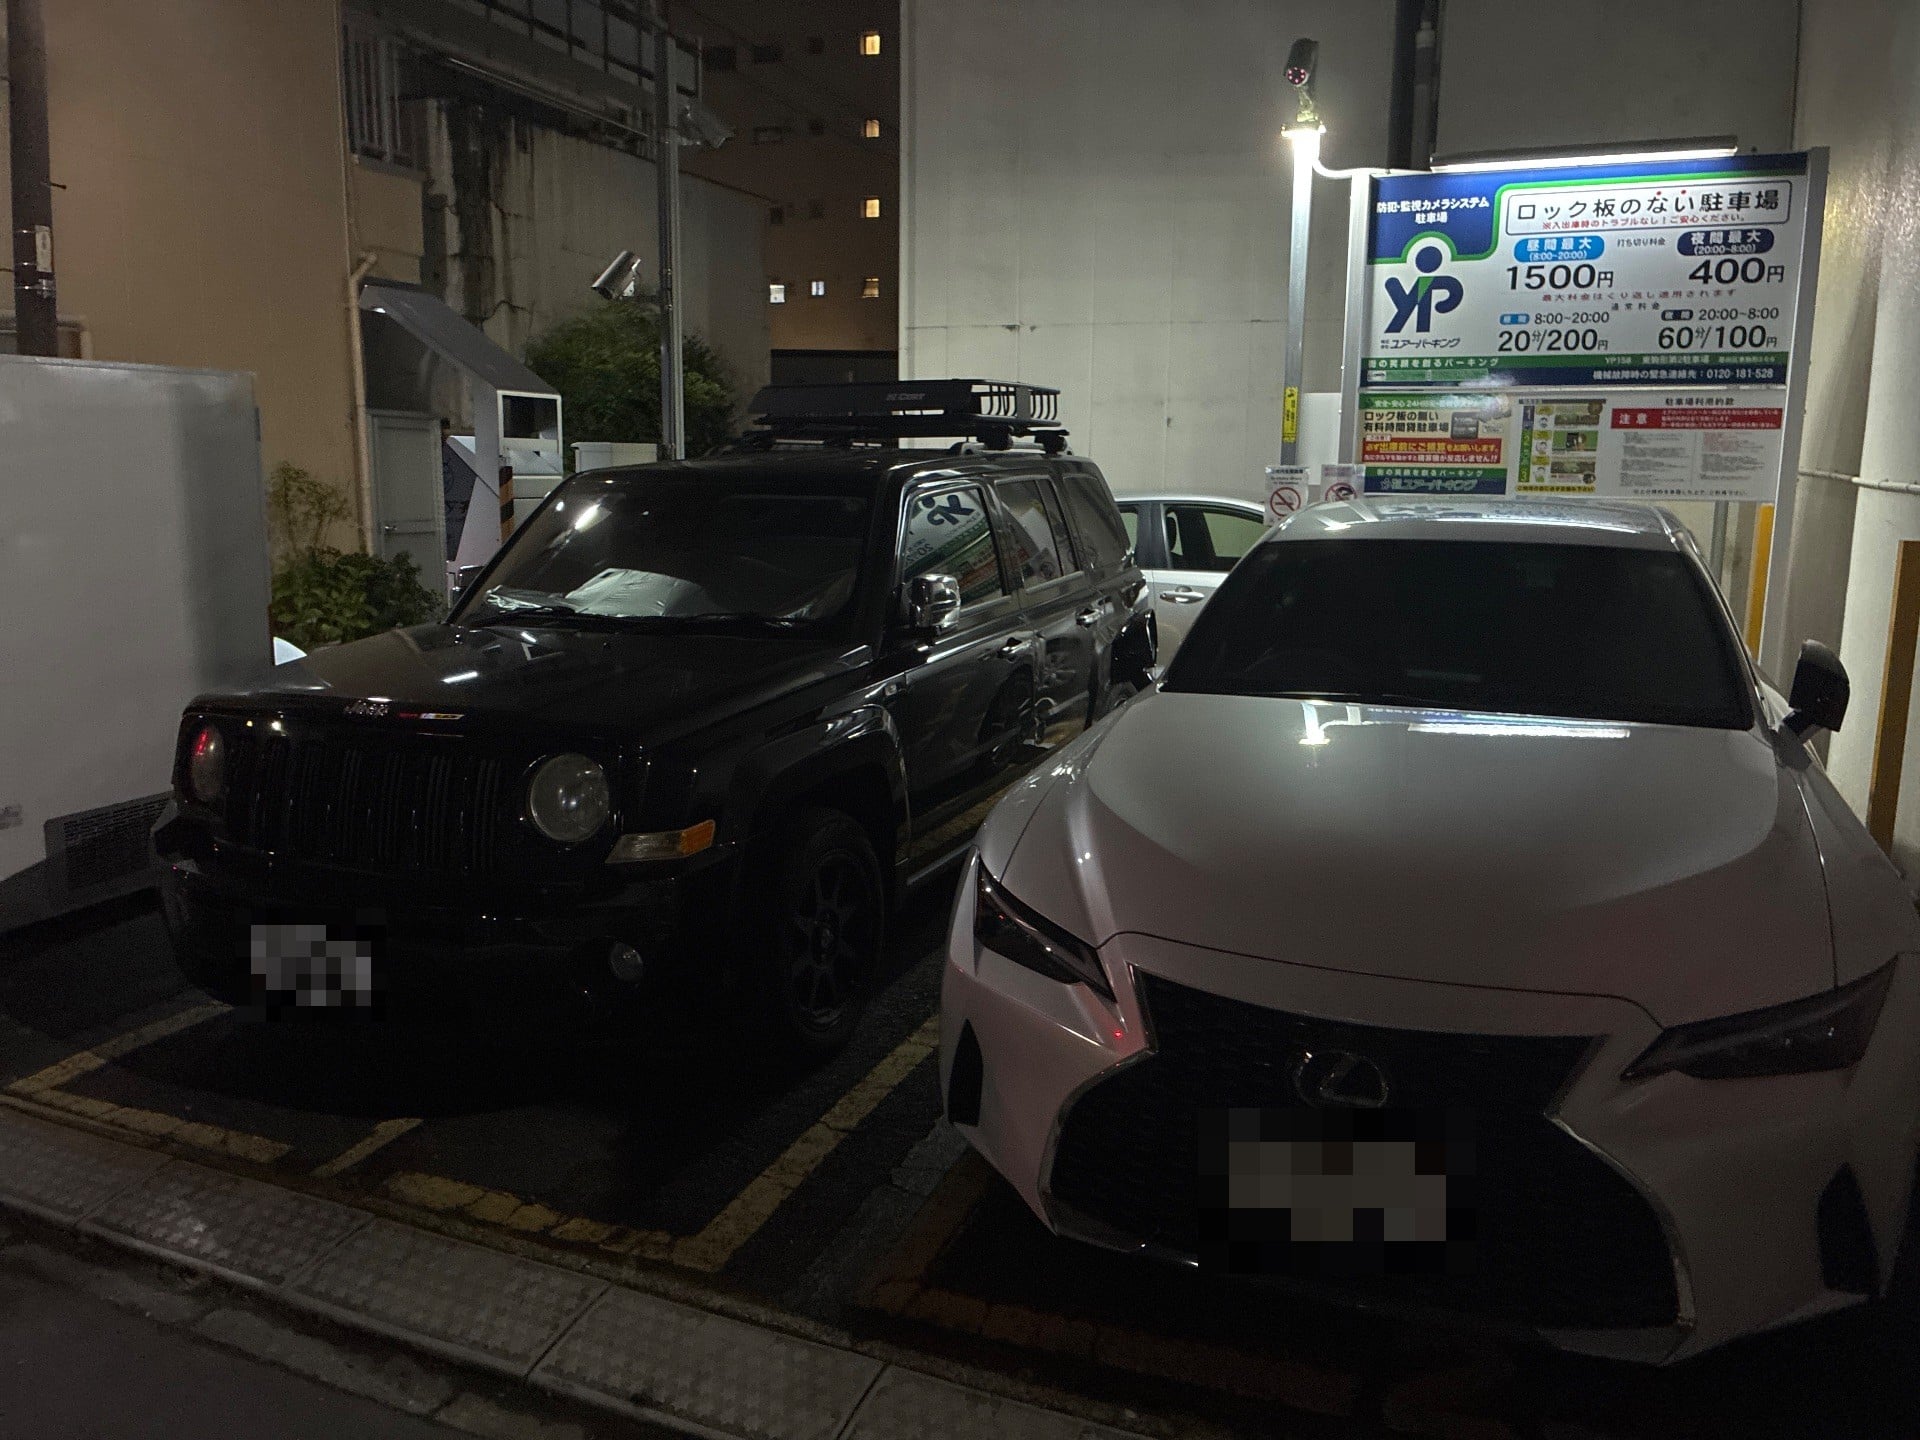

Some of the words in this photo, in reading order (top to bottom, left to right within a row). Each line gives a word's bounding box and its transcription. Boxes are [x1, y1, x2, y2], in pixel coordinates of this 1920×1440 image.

[1376, 197, 1490, 213] 防犯・監視カメラシステム
[1517, 190, 1780, 221] ロック板のない駐車場
[1414, 211, 1448, 224] 駐車場
[1525, 236, 1593, 252] 昼間最大
[1690, 228, 1762, 246] 夜間最大
[1507, 263, 1615, 291] 1500円
[1688, 256, 1785, 286] 400円
